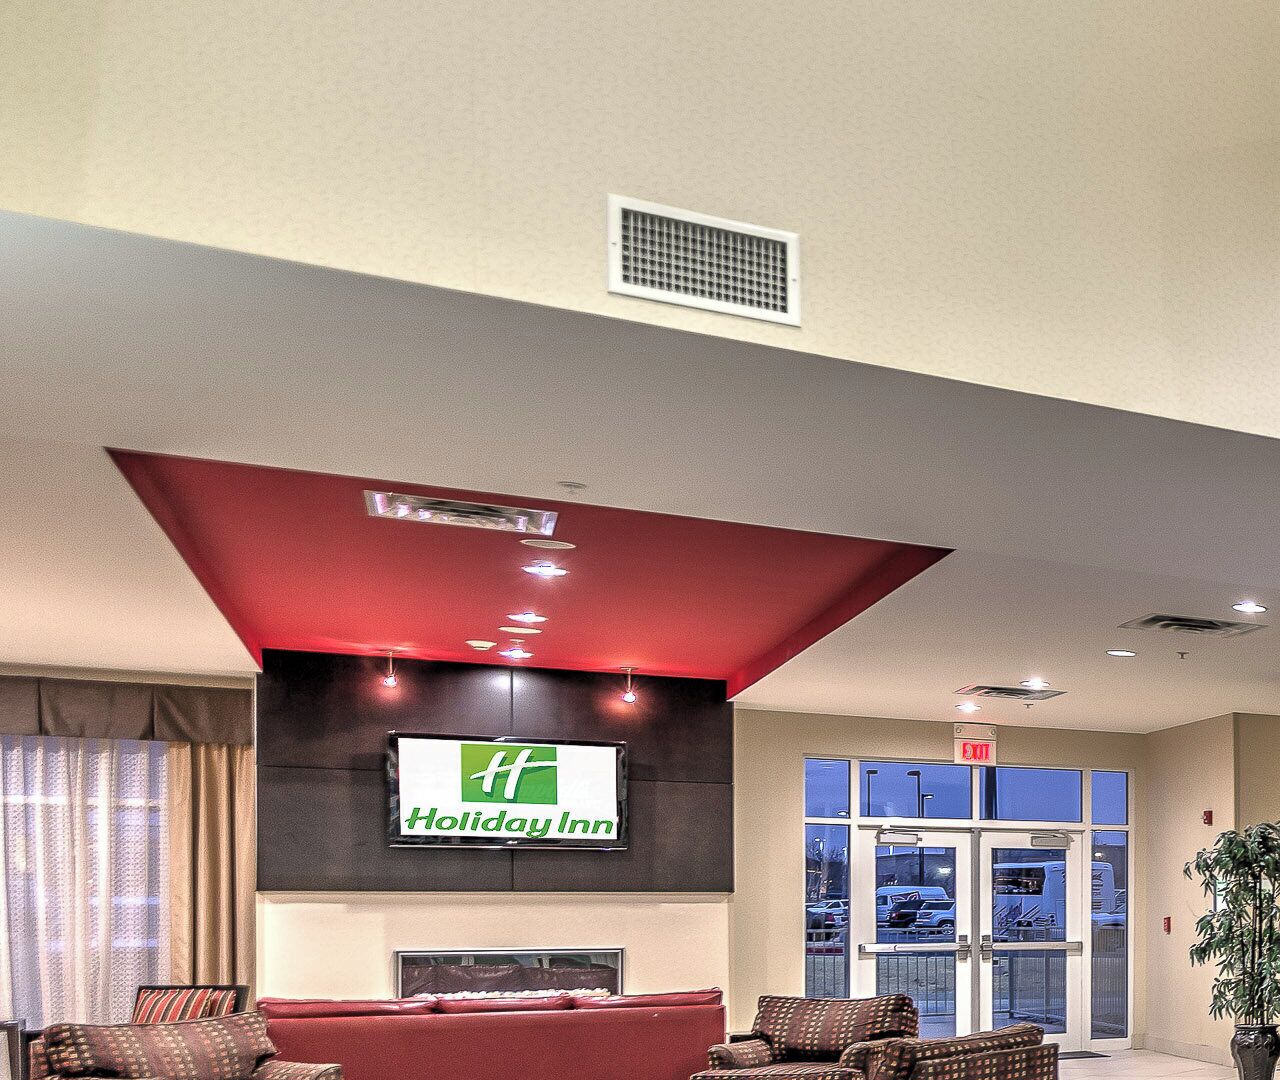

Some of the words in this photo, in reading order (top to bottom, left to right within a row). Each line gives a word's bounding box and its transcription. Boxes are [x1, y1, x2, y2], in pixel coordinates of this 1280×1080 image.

[962, 742, 990, 761] EXIT
[405, 807, 552, 838] Holiday
[557, 811, 614, 834] Inn
